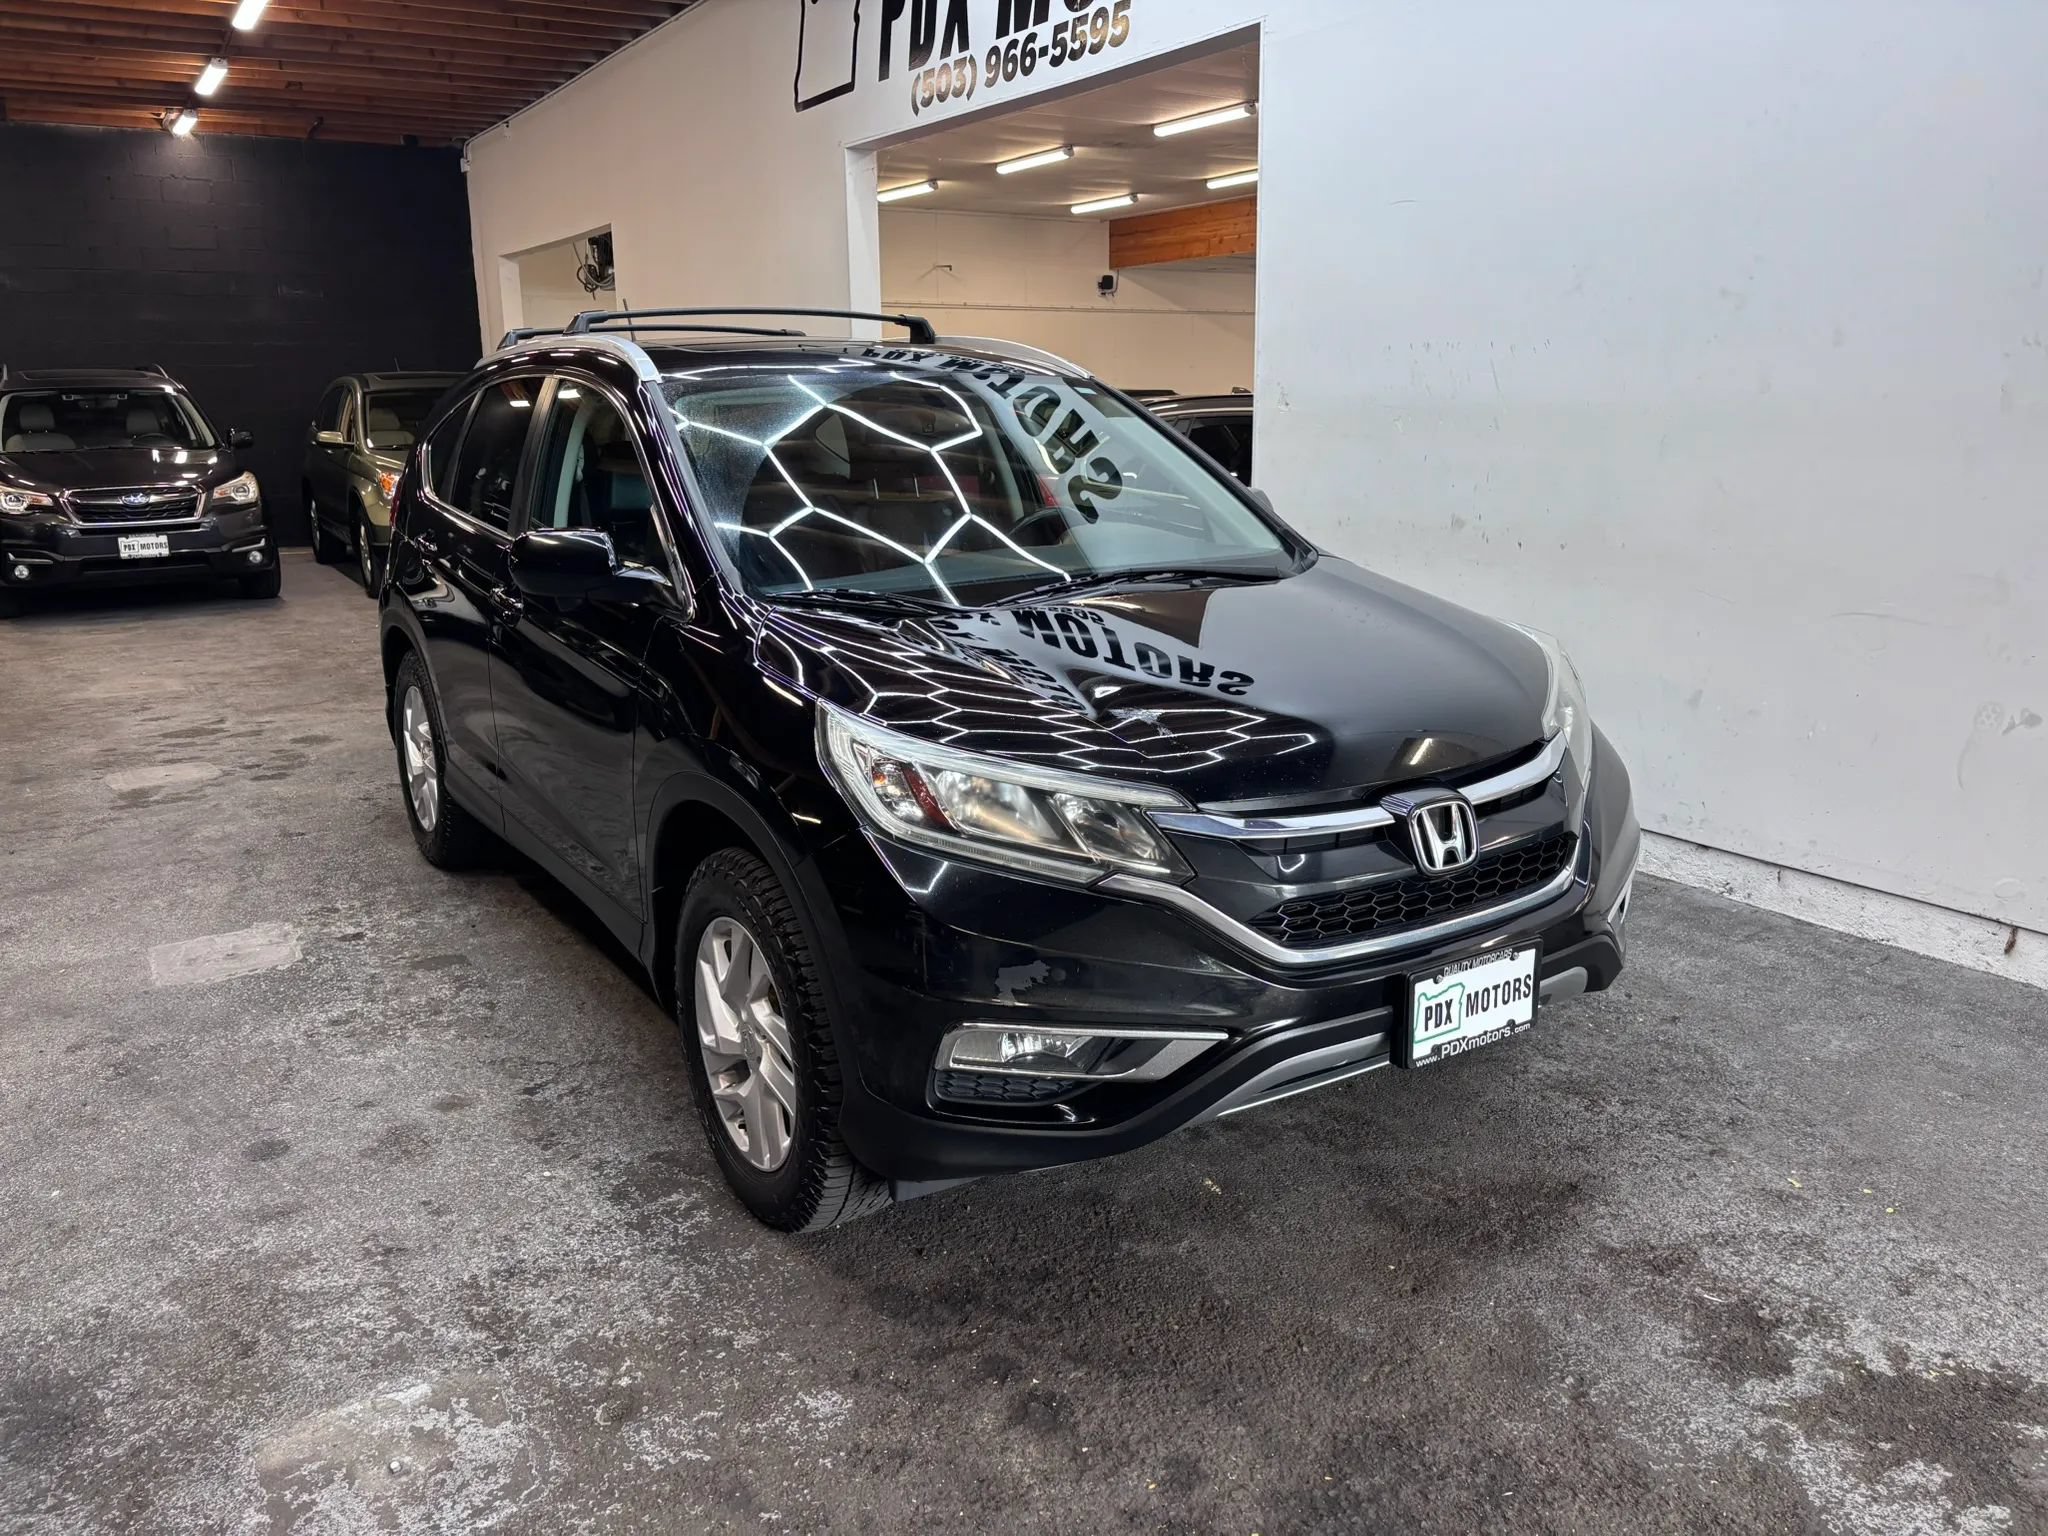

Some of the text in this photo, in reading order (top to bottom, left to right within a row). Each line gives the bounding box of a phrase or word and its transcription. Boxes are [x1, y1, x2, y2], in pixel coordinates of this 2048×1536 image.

[911, 54, 977, 117] (503)
[984, 1, 1132, 88] 966-5595
[140, 542, 168, 550] MOTORS
[1424, 973, 1532, 1032] PDX MOTORS
[1415, 1023, 1531, 1067] www.PDXmotors.com
